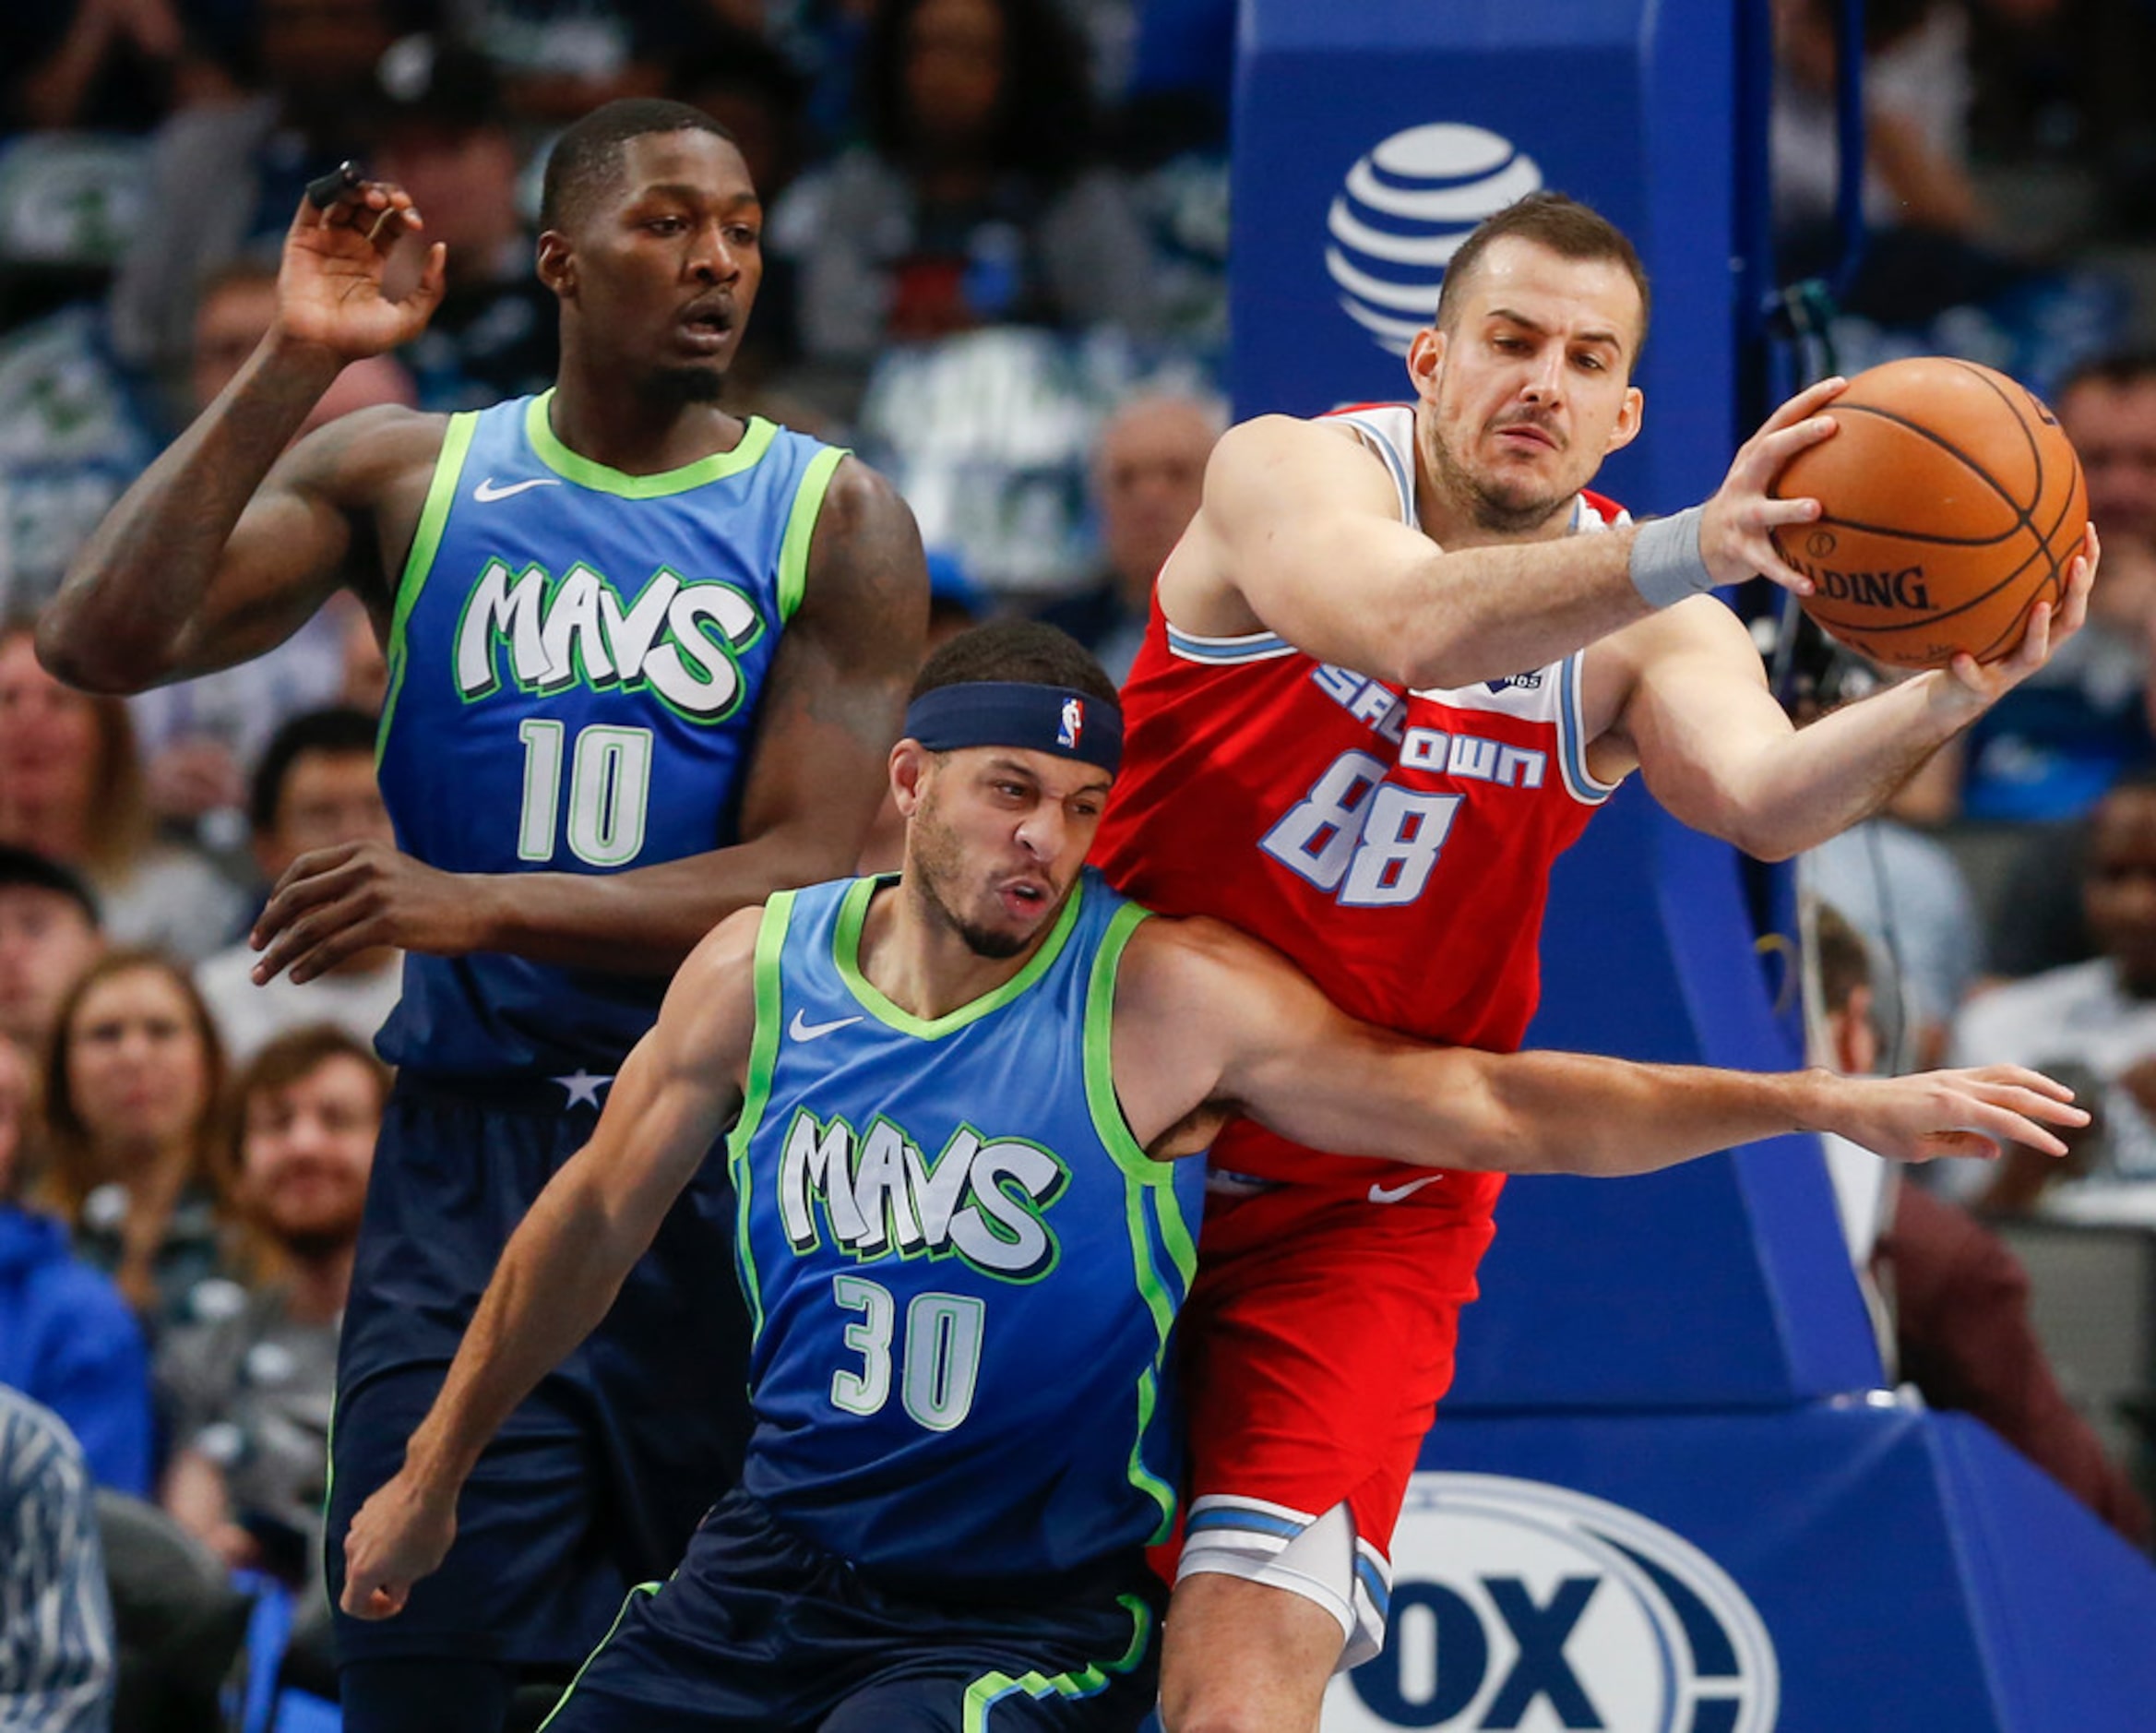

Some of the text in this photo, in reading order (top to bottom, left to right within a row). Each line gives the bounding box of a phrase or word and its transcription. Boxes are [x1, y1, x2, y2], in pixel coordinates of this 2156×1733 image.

[453, 556, 767, 725] MAVS
[518, 719, 653, 866] 10
[1257, 747, 1466, 908] 88
[779, 1105, 1073, 1285] MAVS
[830, 1273, 985, 1432] 30
[1348, 1574, 1606, 1731] OX
